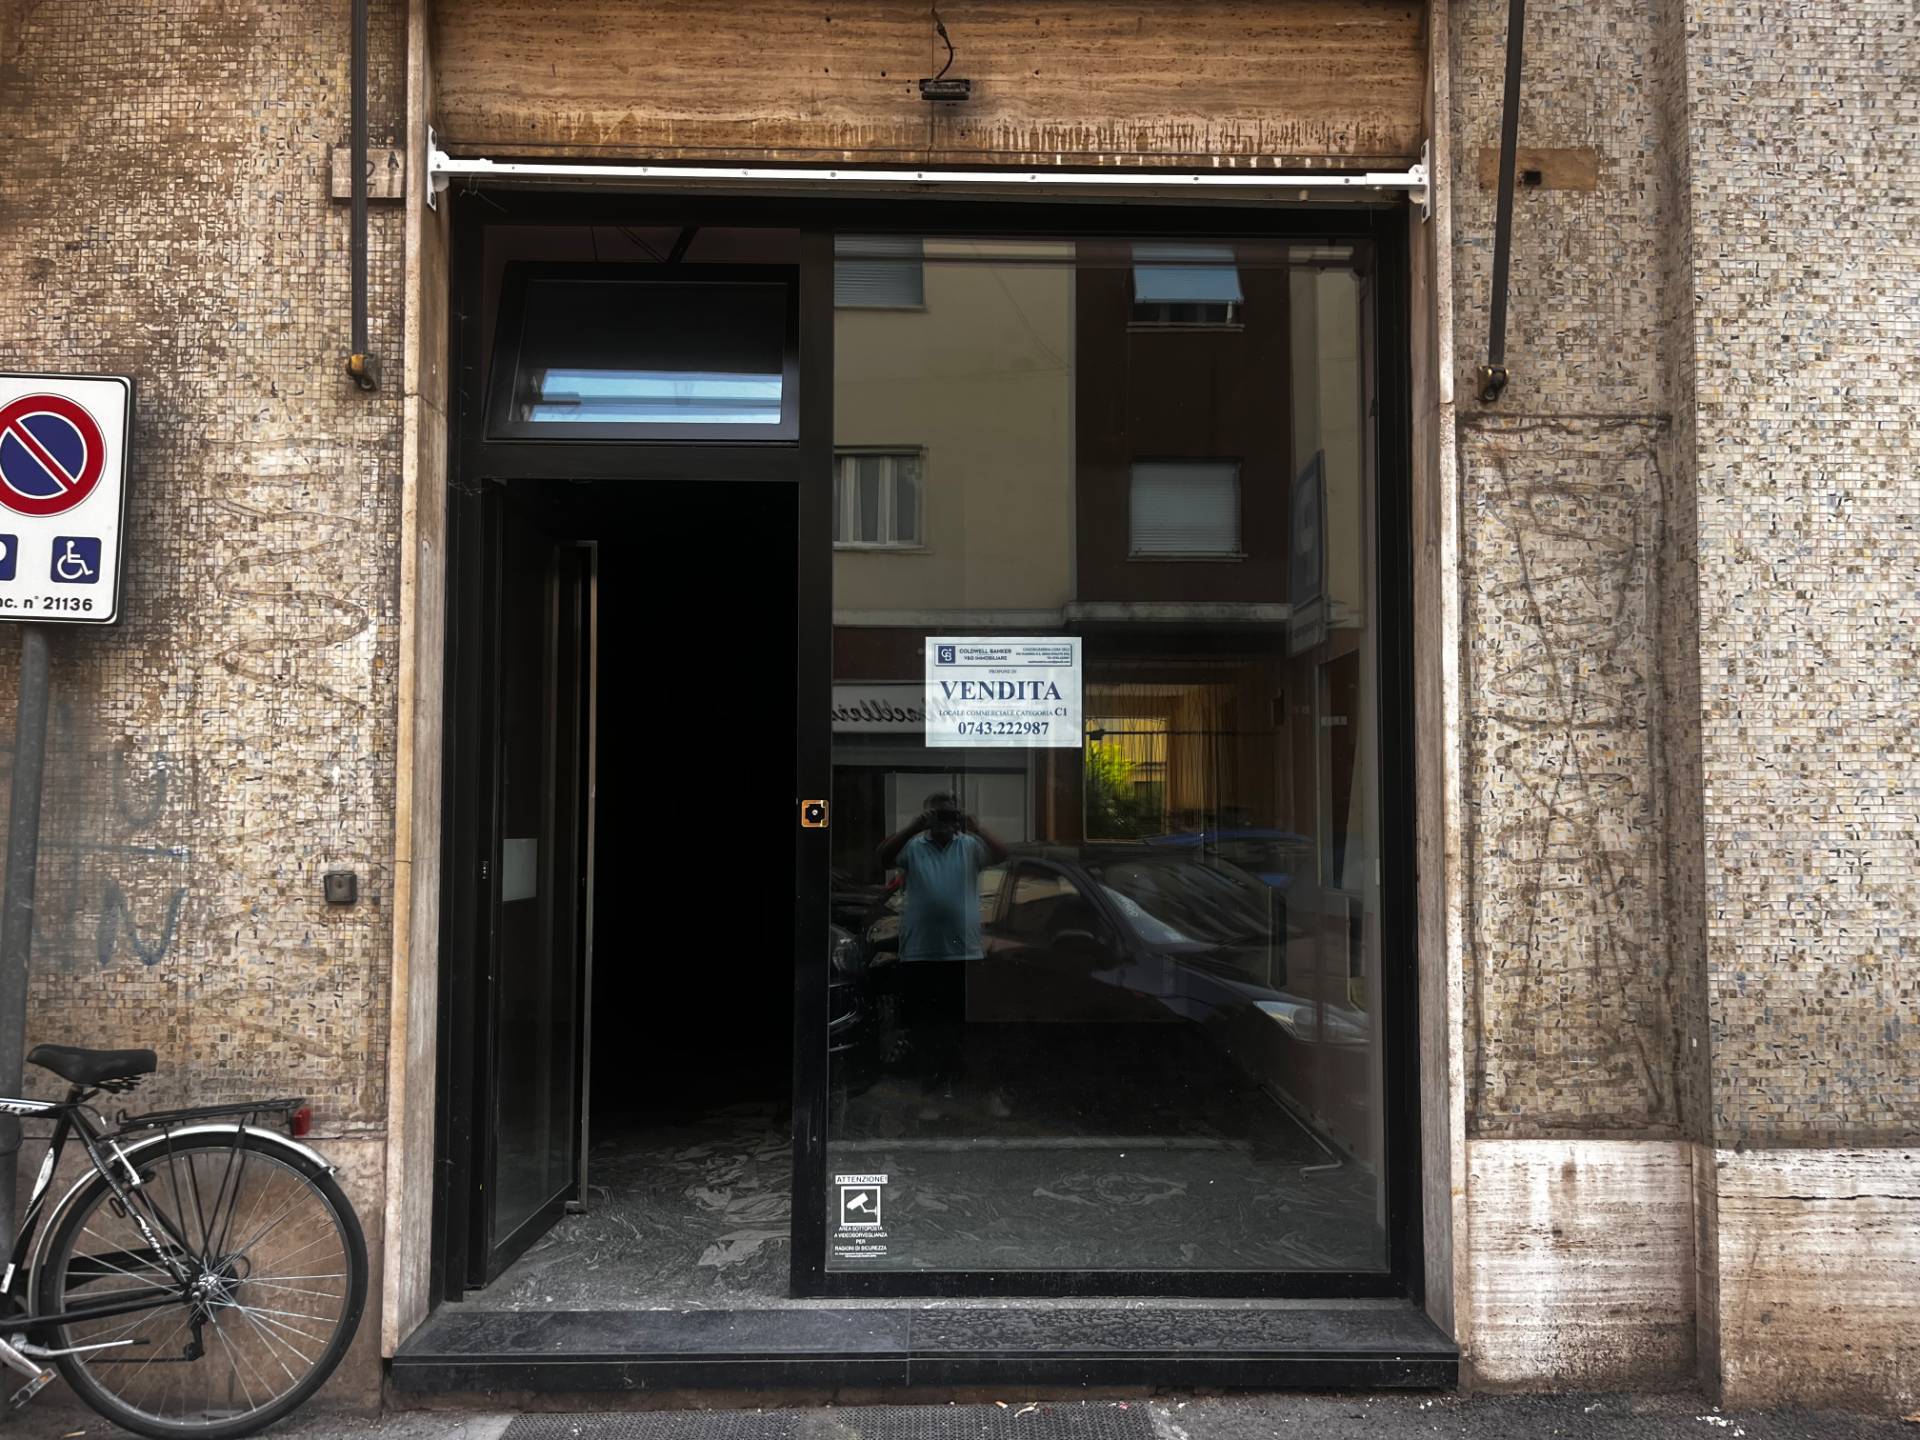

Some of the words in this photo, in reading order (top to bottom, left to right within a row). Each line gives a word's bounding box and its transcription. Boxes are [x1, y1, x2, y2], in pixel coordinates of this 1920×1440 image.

[0, 597, 18, 608] c.
[43, 596, 94, 611] 21136
[940, 680, 1062, 700] VENDITA
[939, 709, 964, 717] LOCALE
[1054, 707, 1068, 717] C1
[958, 721, 1050, 735] 0743.222987
[836, 1175, 887, 1183] ATTENZIONE!
